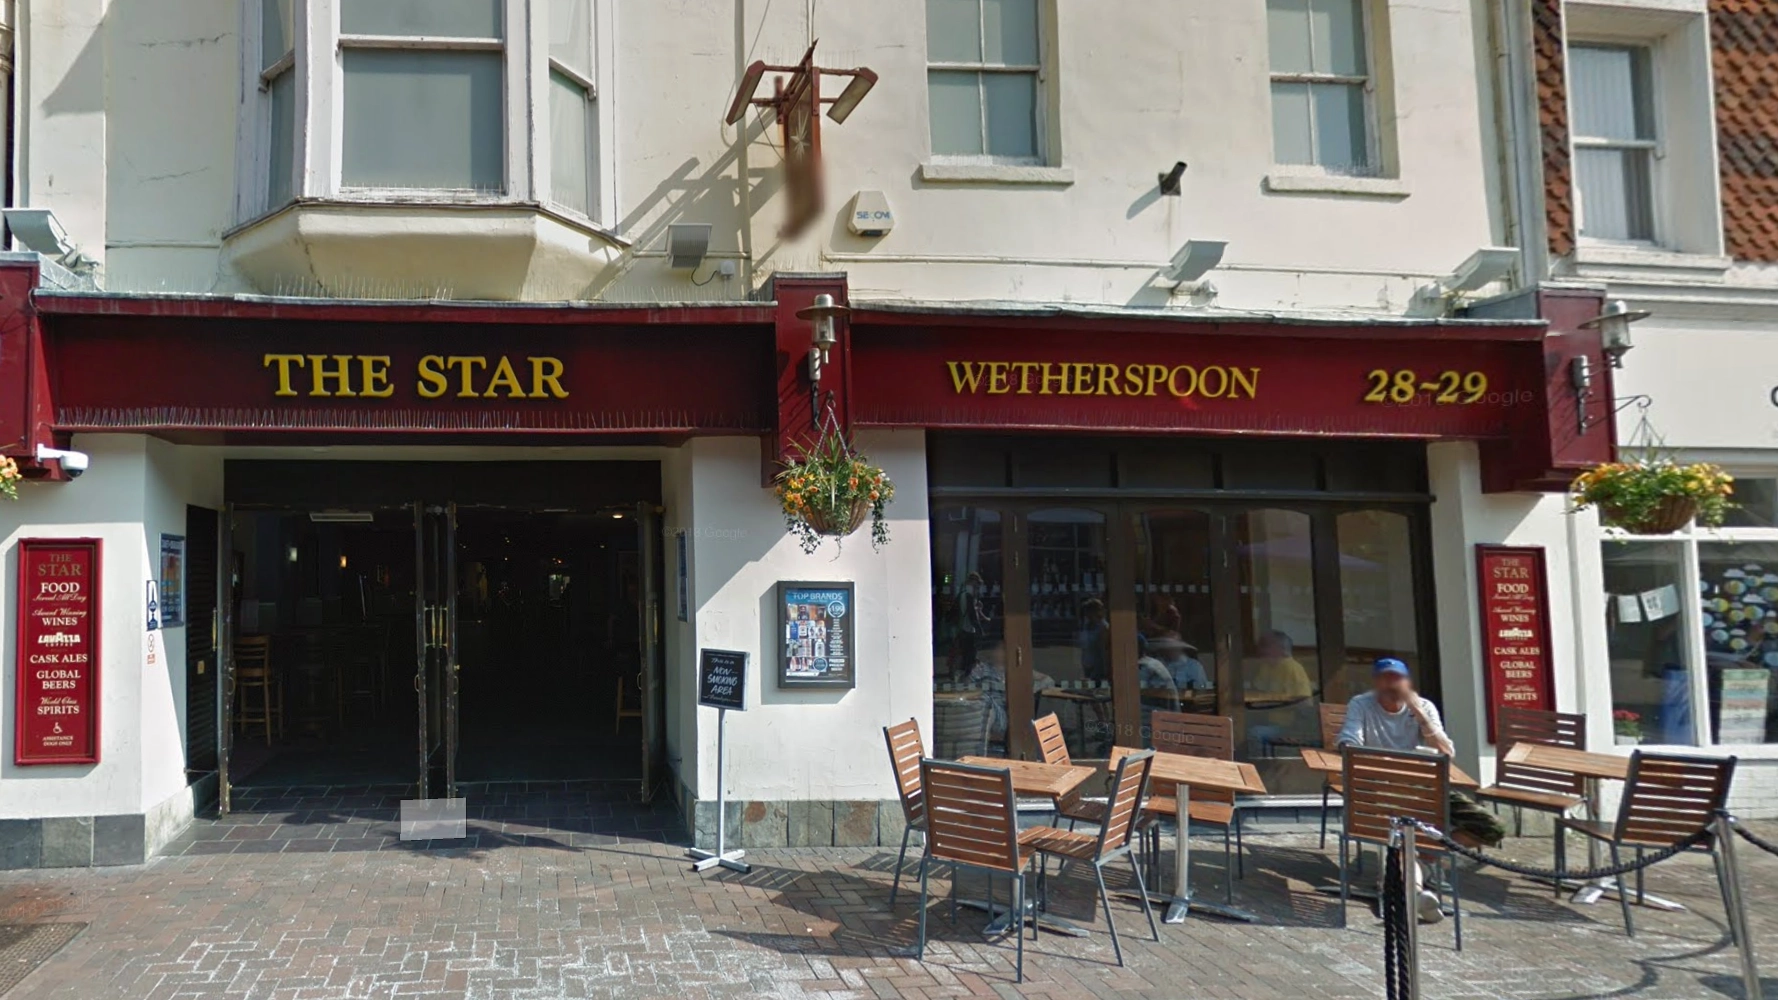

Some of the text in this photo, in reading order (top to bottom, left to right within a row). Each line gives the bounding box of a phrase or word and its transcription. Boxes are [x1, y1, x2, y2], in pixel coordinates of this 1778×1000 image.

[264, 354, 569, 398] THE STAR
[946, 361, 1261, 399] WETHERSPOON
[50, 554, 72, 562] THE
[38, 564, 82, 576] STAR
[1493, 567, 1529, 578] STAR
[41, 582, 80, 593] FOOD
[1497, 583, 1529, 593] FOOD
[42, 617, 78, 626] WINES
[38, 632, 80, 644] LAVAZZA
[1494, 647, 1540, 655] CASK ALES
[30, 654, 88, 663] CASK ALES
[36, 670, 81, 679] GLOBAL
[42, 681, 76, 689] BEERS
[707, 674, 738, 686] SMOKING
[710, 684, 732, 695] AREA
[37, 706, 80, 714] SPIRITS
